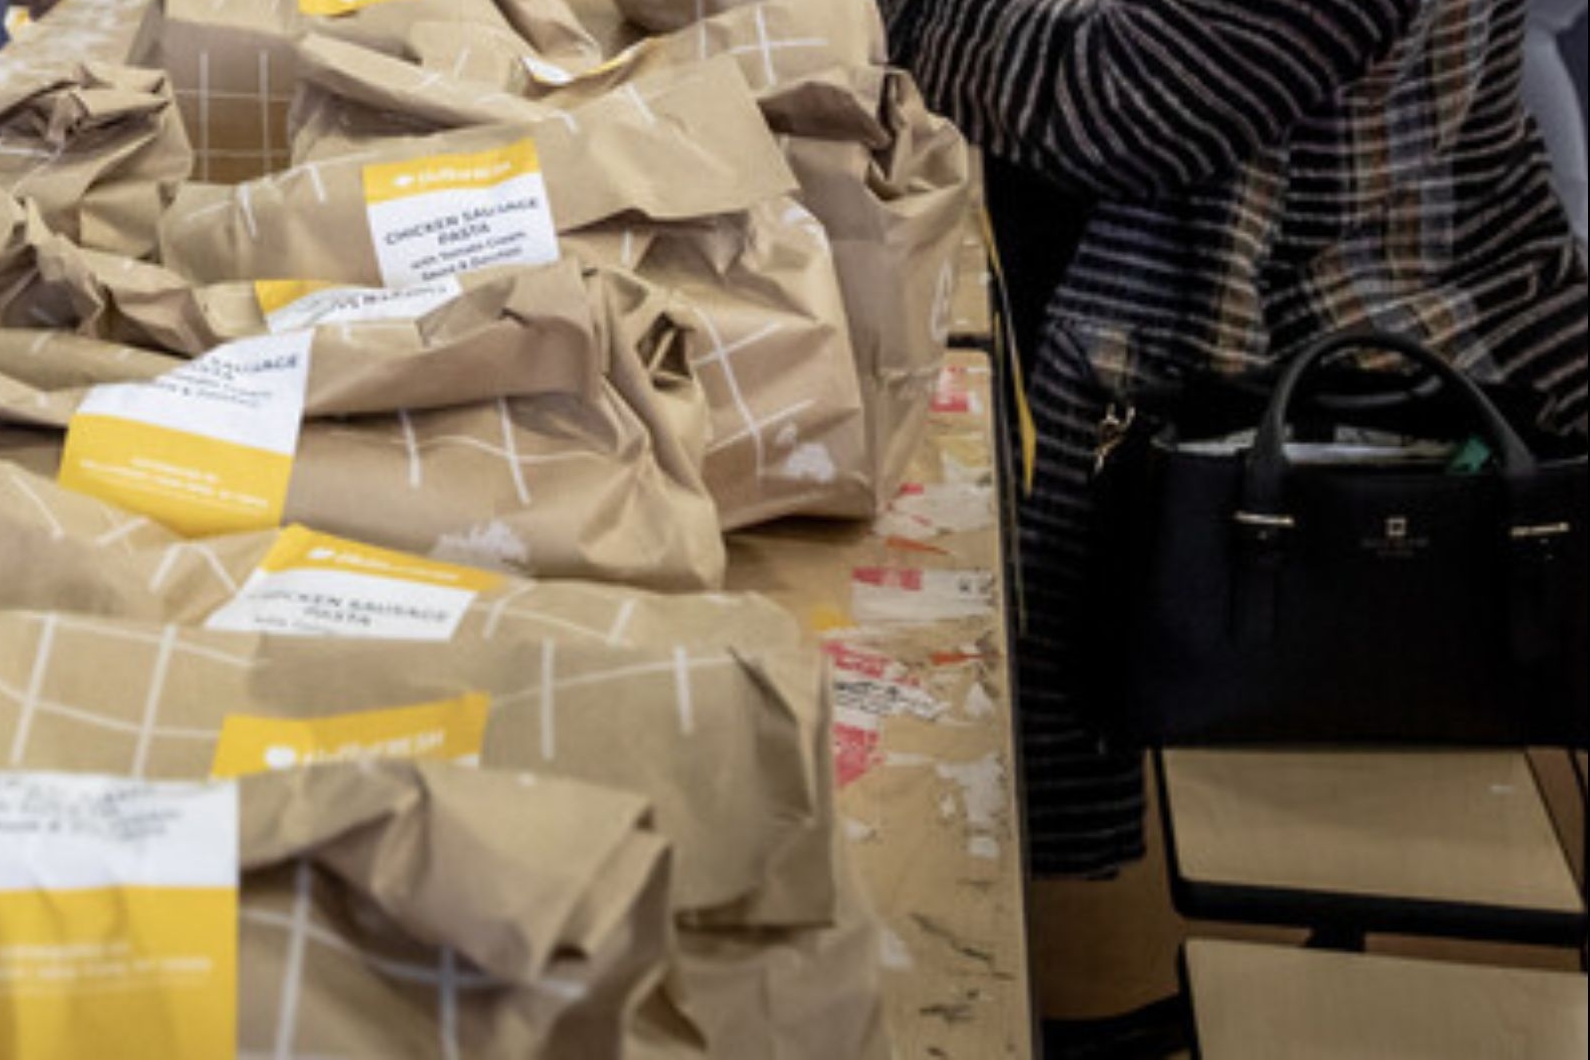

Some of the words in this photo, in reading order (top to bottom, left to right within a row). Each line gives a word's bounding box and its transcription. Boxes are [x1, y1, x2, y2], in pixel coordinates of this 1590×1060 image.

[385, 214, 459, 245] CHICKEN
[461, 197, 538, 222] SAUSAGE
[438, 222, 492, 246] PASTA
